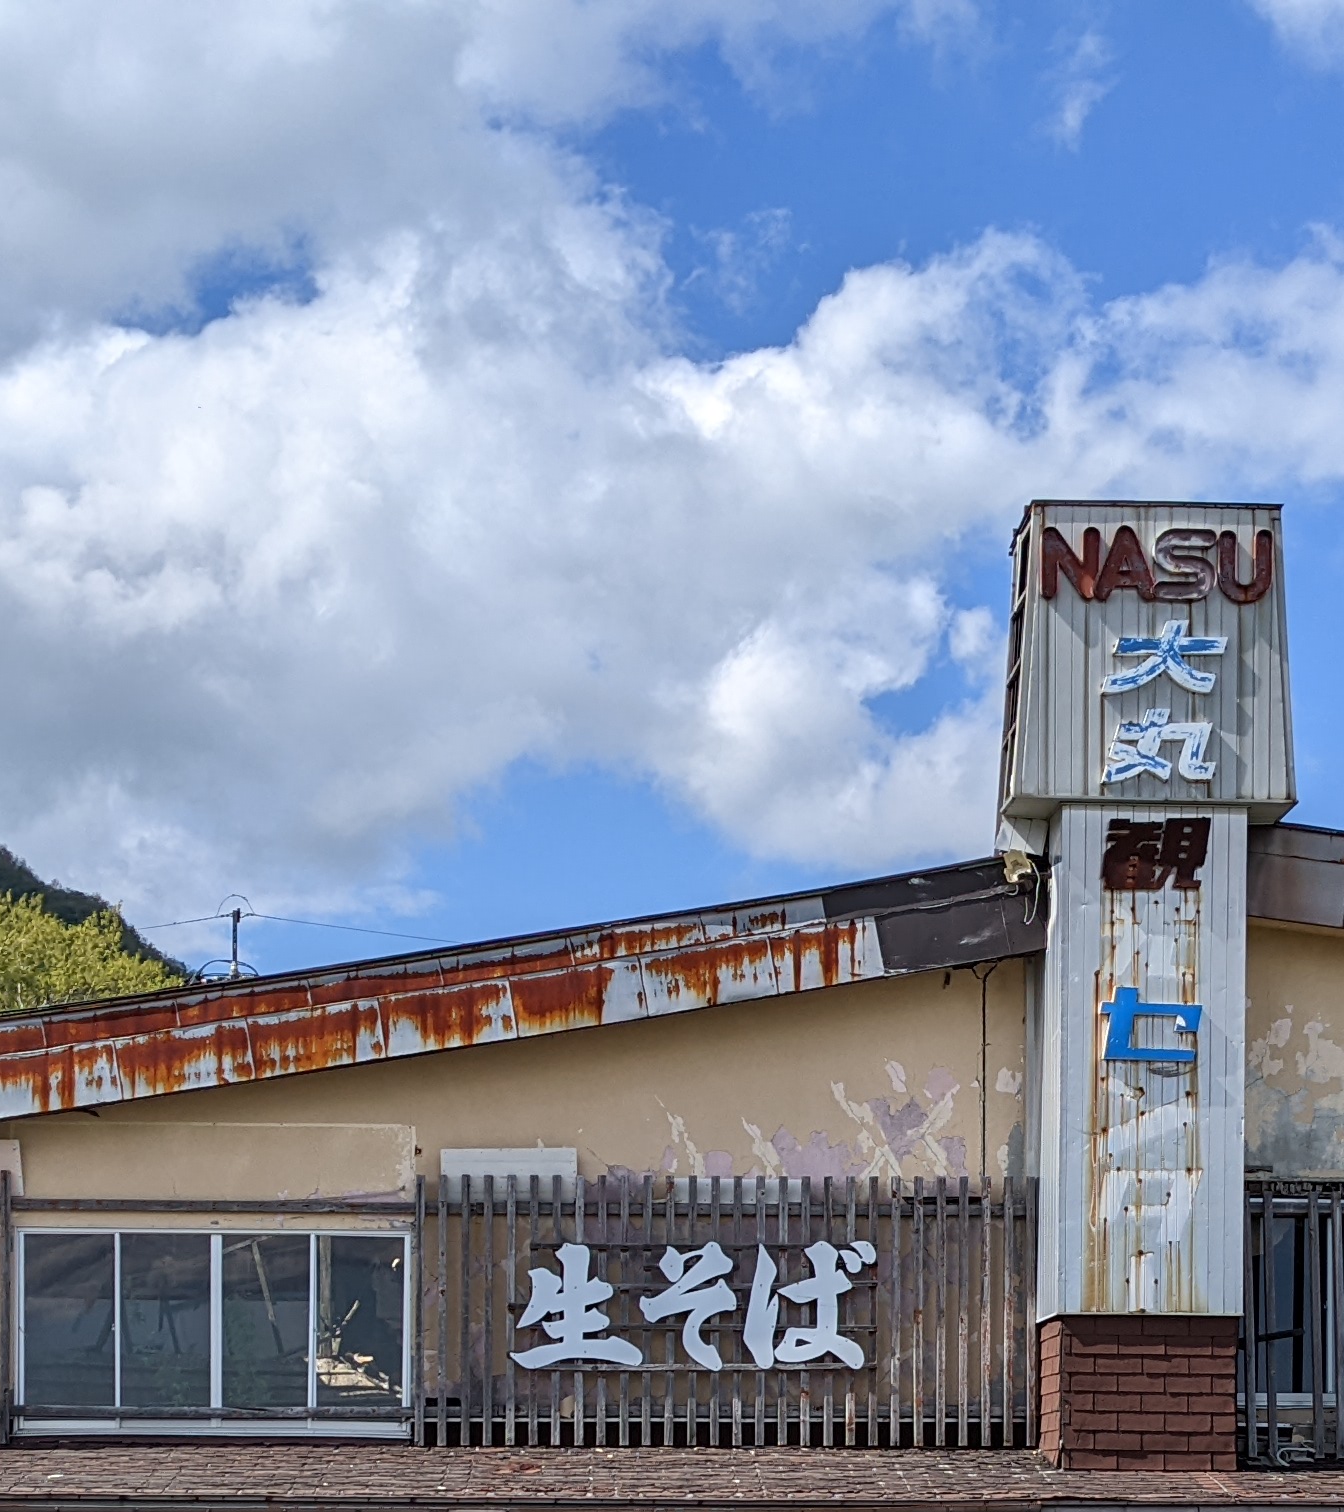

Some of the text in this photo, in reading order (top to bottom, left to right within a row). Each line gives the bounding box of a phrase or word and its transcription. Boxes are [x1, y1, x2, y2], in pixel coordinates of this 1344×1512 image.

[1039, 524, 1274, 605] NASU
[508, 1240, 878, 1372] 生そば
